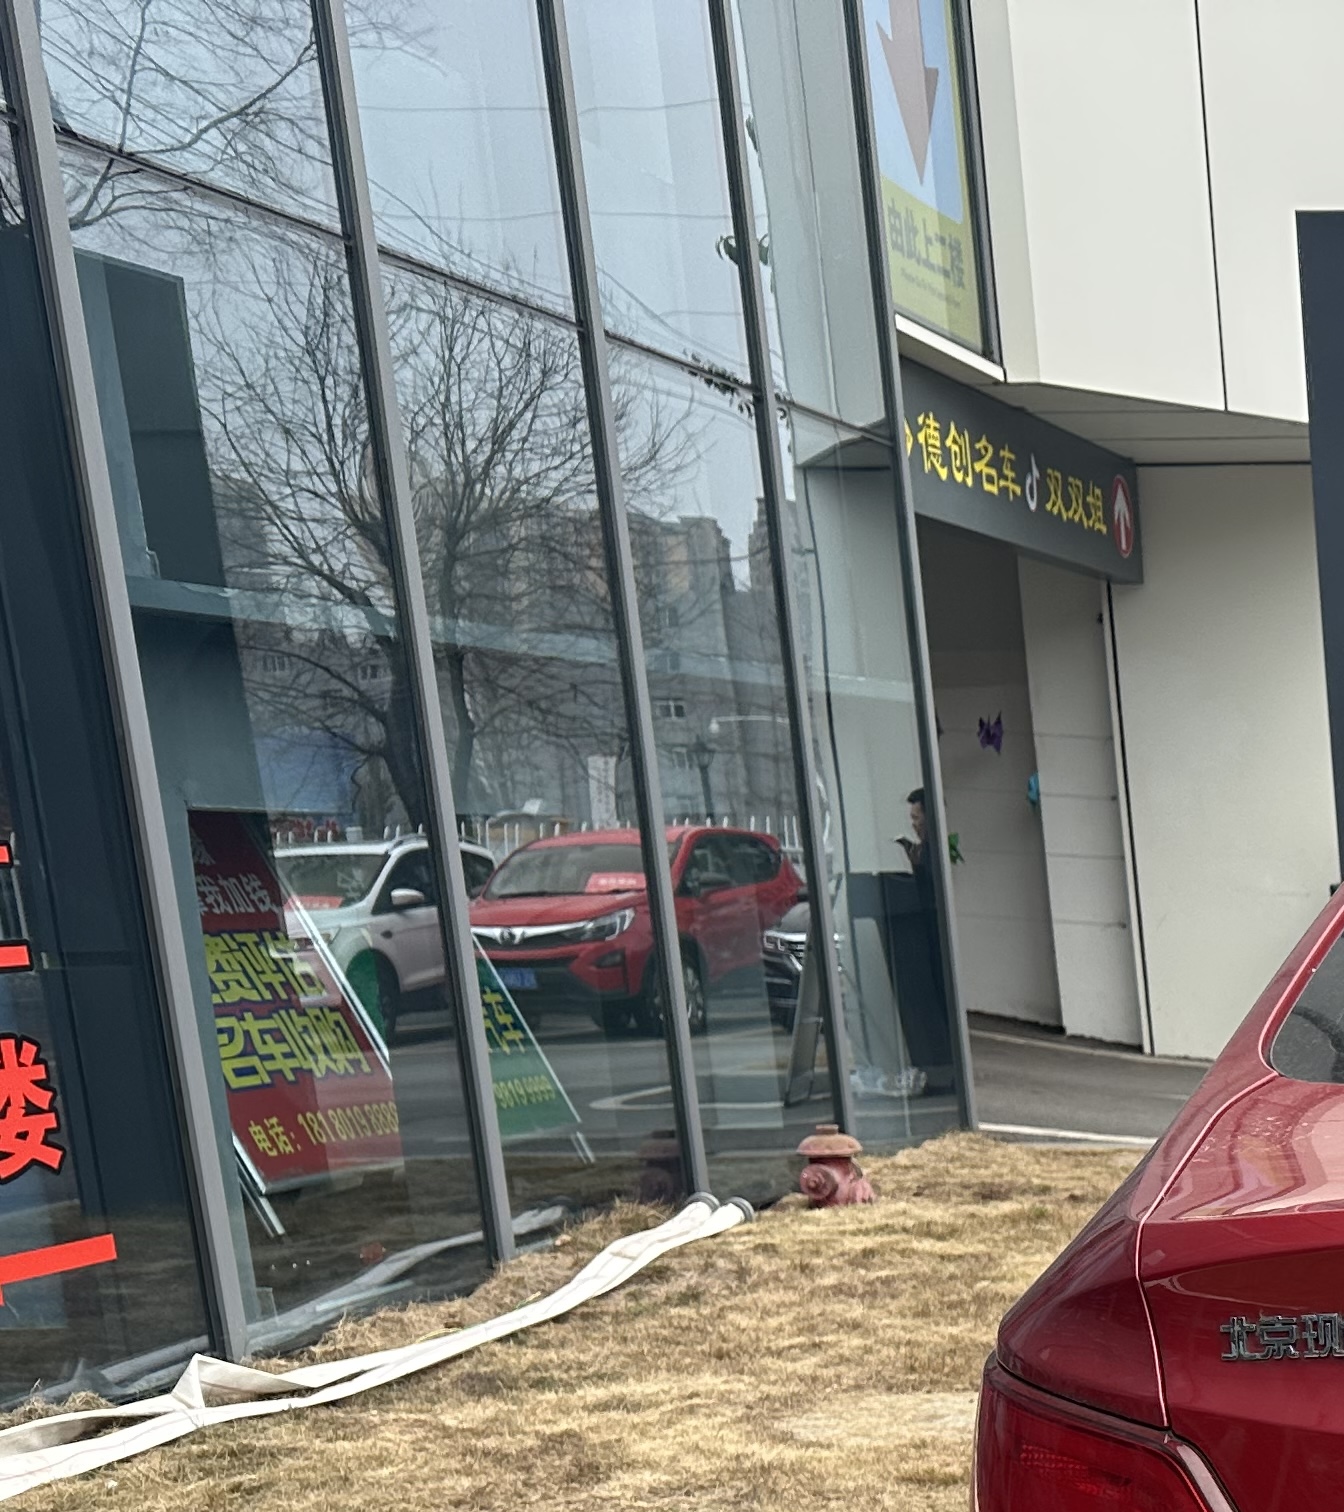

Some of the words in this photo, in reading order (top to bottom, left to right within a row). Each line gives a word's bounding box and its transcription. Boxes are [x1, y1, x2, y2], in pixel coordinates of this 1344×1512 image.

[888, 197, 965, 290] 由此上二楼
[917, 411, 1022, 502] 德创名车
[1045, 468, 1108, 535] 双双姐
[199, 872, 282, 916] 我加钱
[204, 931, 327, 1004] 费评估
[214, 1005, 372, 1090] 名车收购
